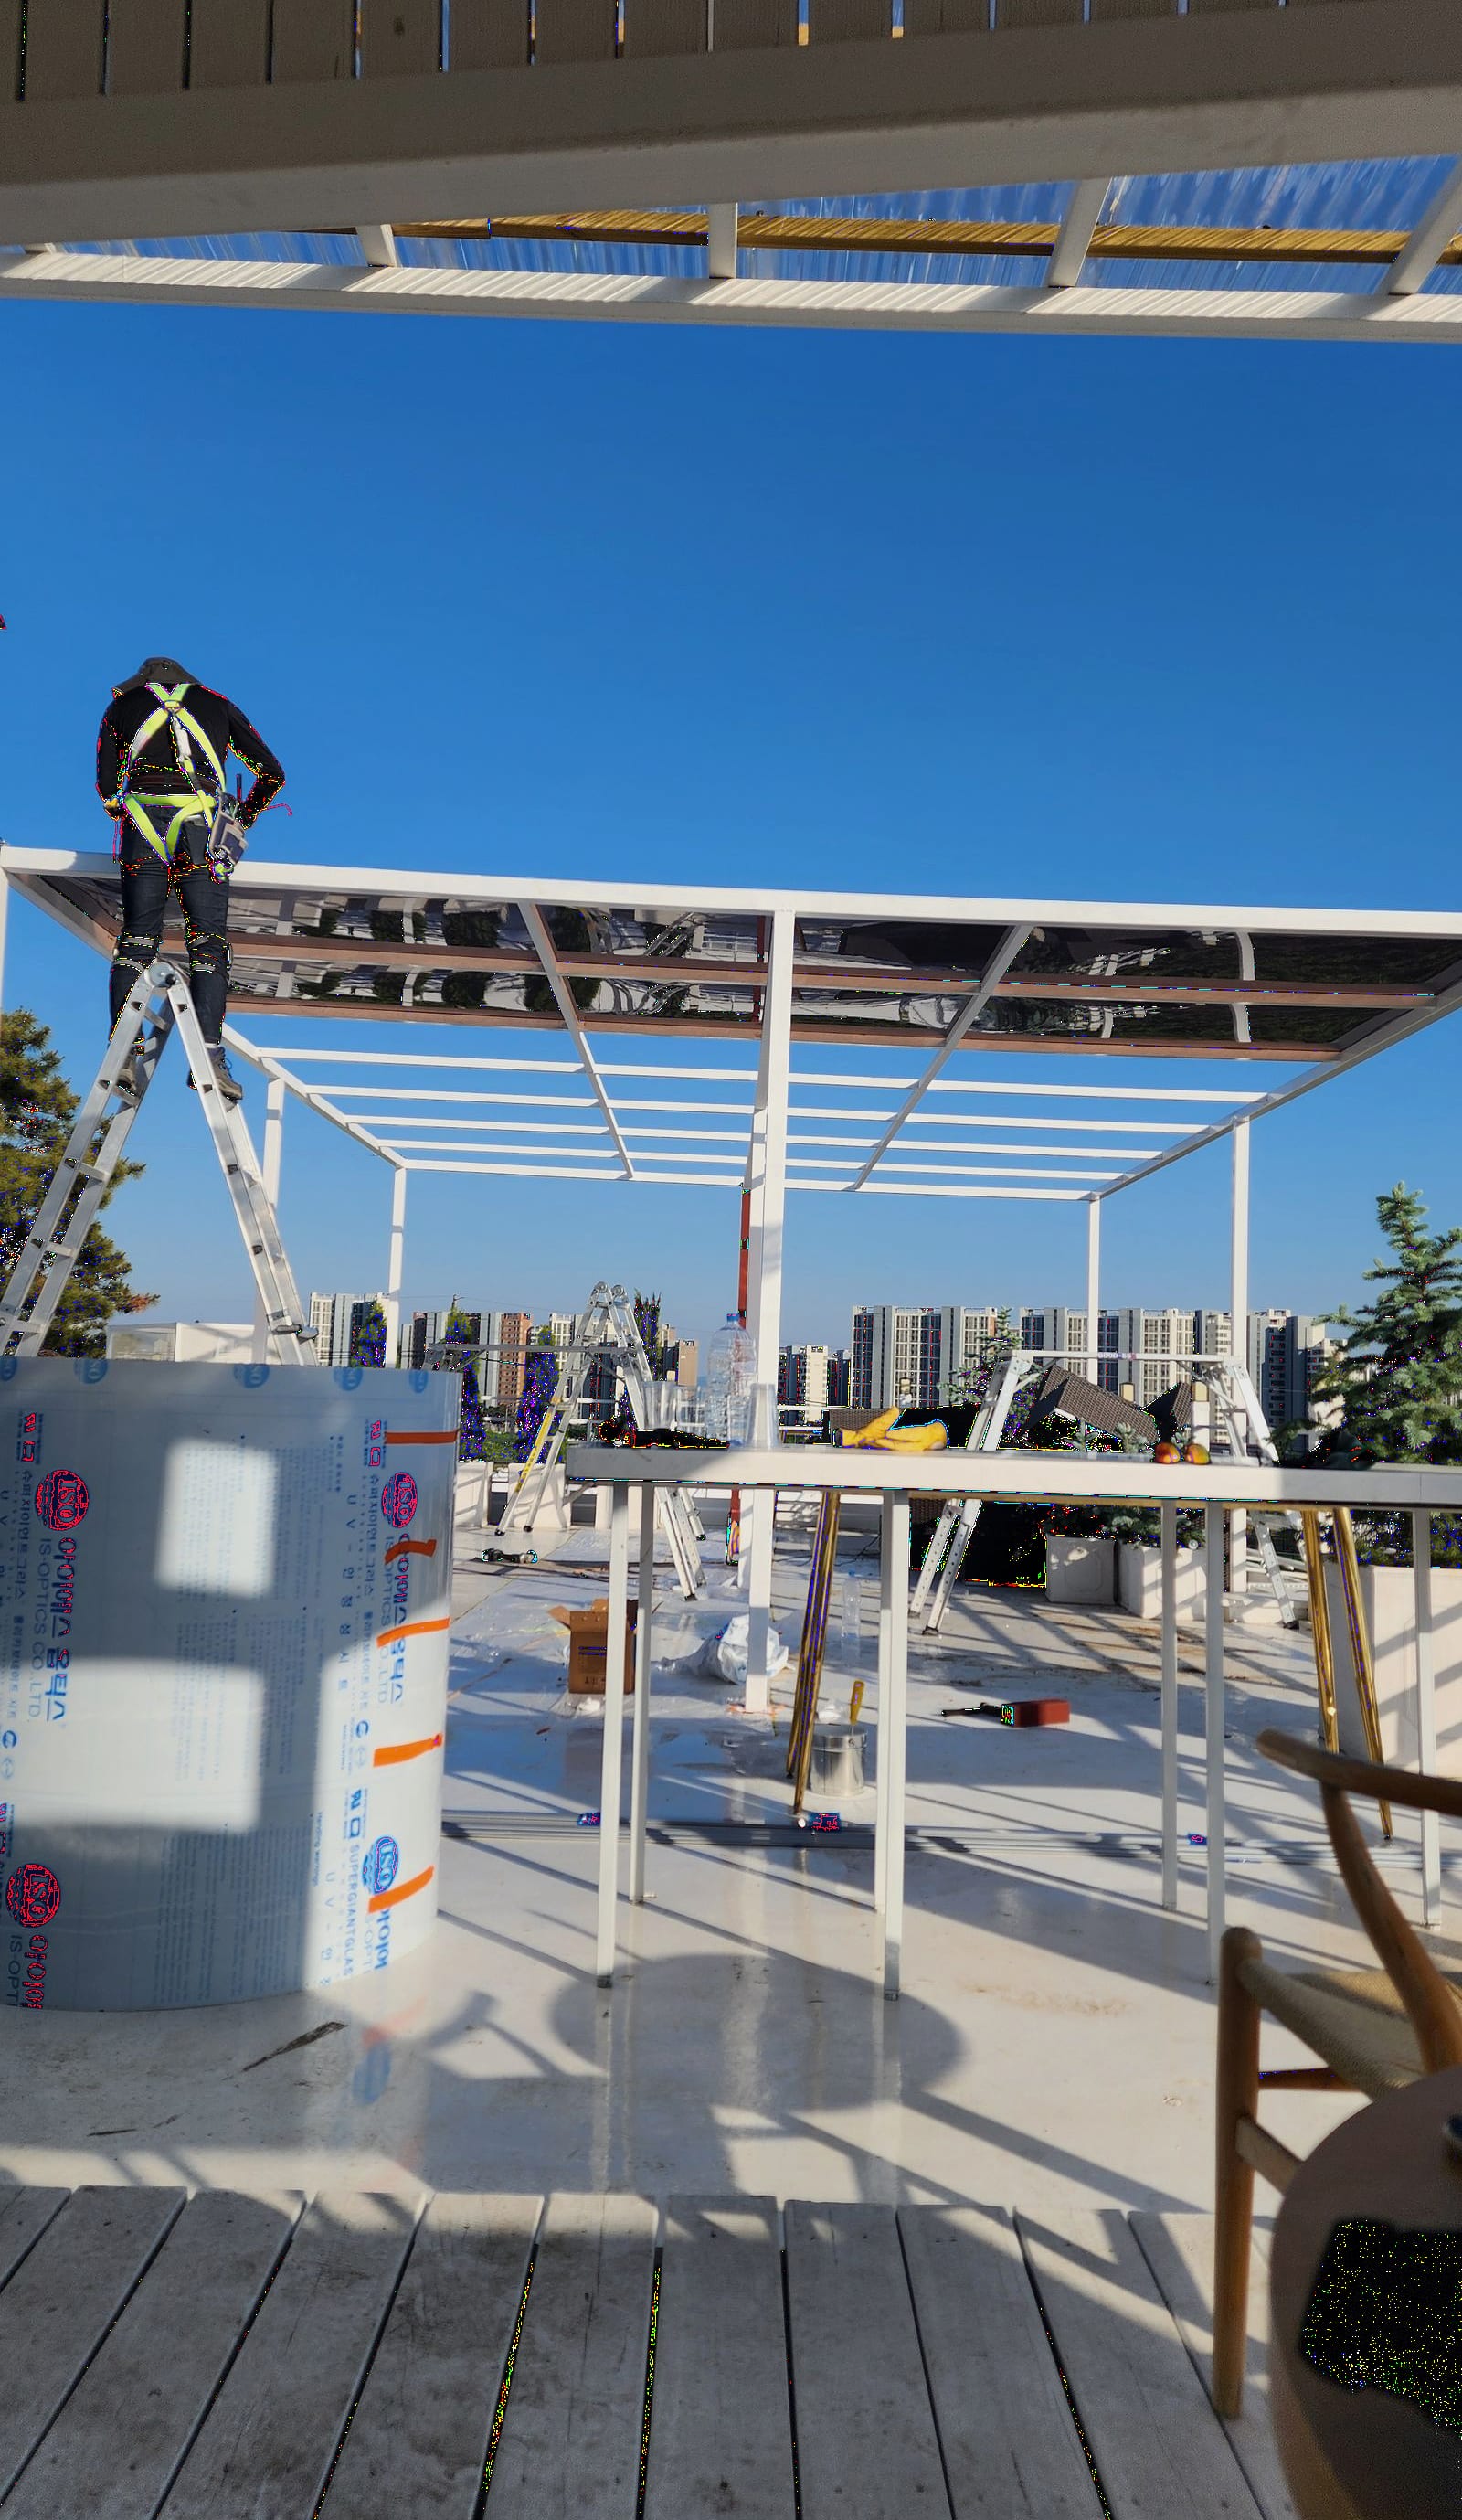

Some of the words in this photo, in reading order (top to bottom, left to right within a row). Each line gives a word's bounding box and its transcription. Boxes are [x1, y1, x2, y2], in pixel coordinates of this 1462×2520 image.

[57, 1480, 77, 1523] ISO
[34, 1538, 51, 1634] IS-OPTICS
[28, 1874, 49, 1919] ISO
